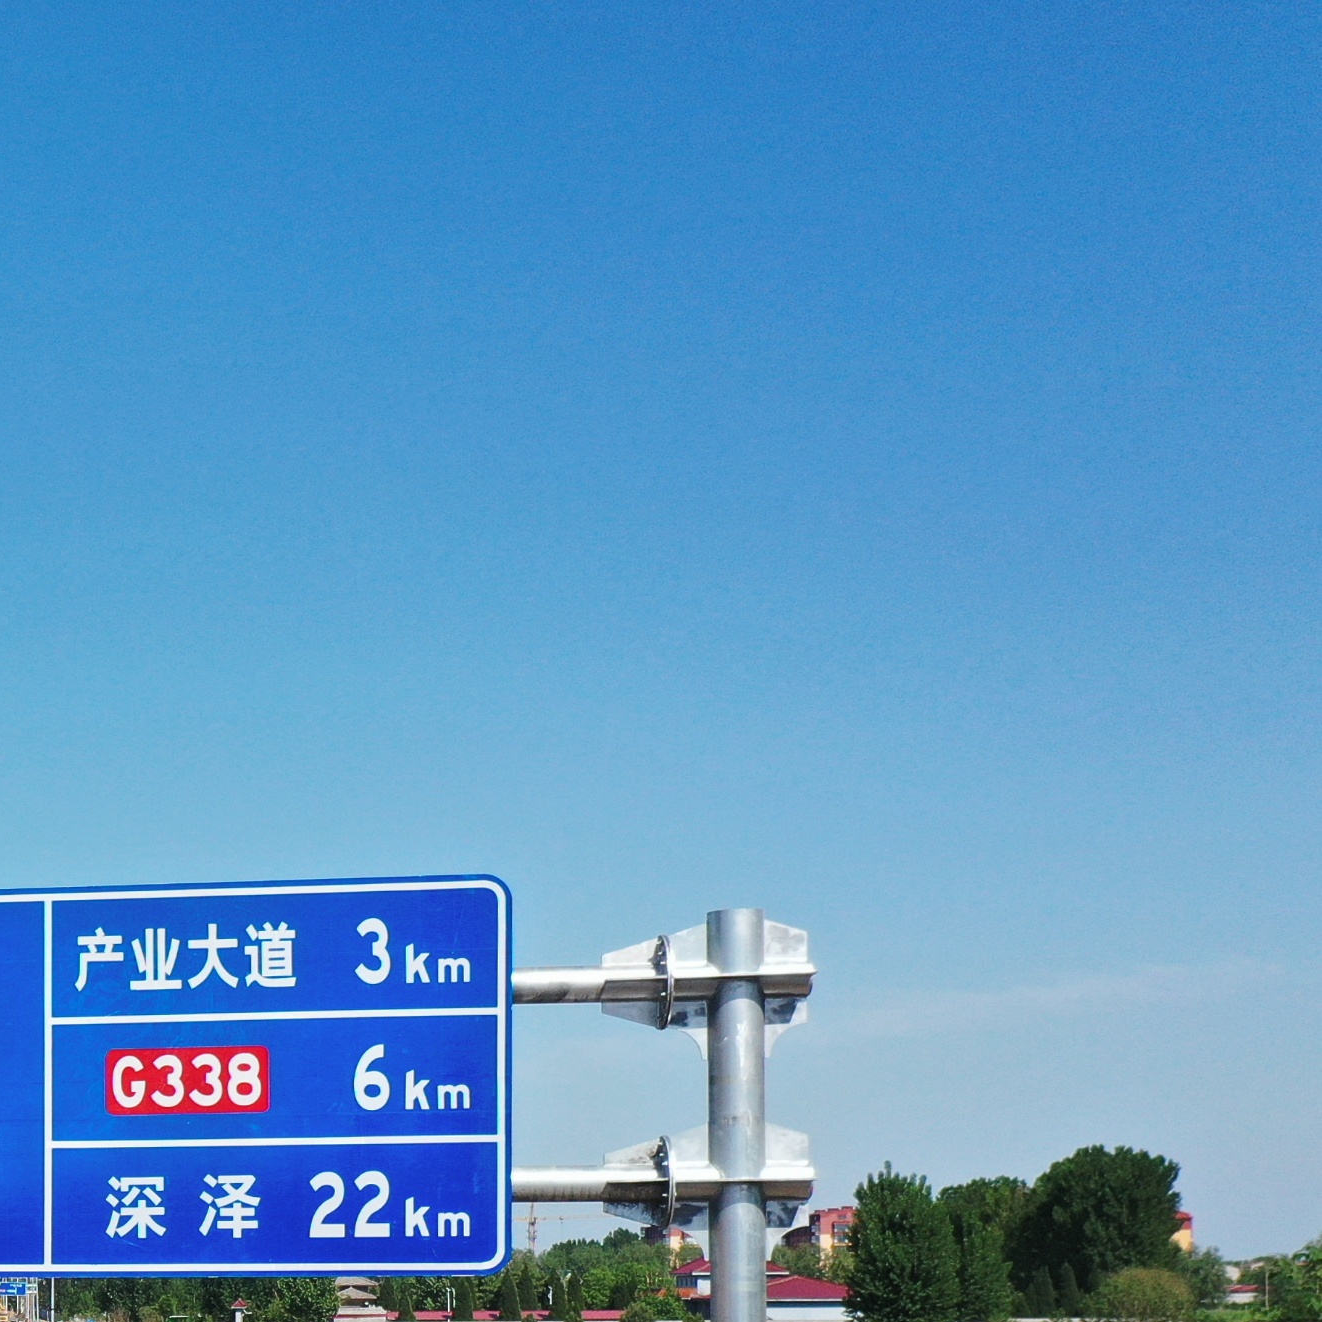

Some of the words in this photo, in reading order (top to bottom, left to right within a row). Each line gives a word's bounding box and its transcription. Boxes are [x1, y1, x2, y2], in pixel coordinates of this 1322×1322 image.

[74, 922, 297, 991] 产业大道
[112, 1053, 262, 1108] G338
